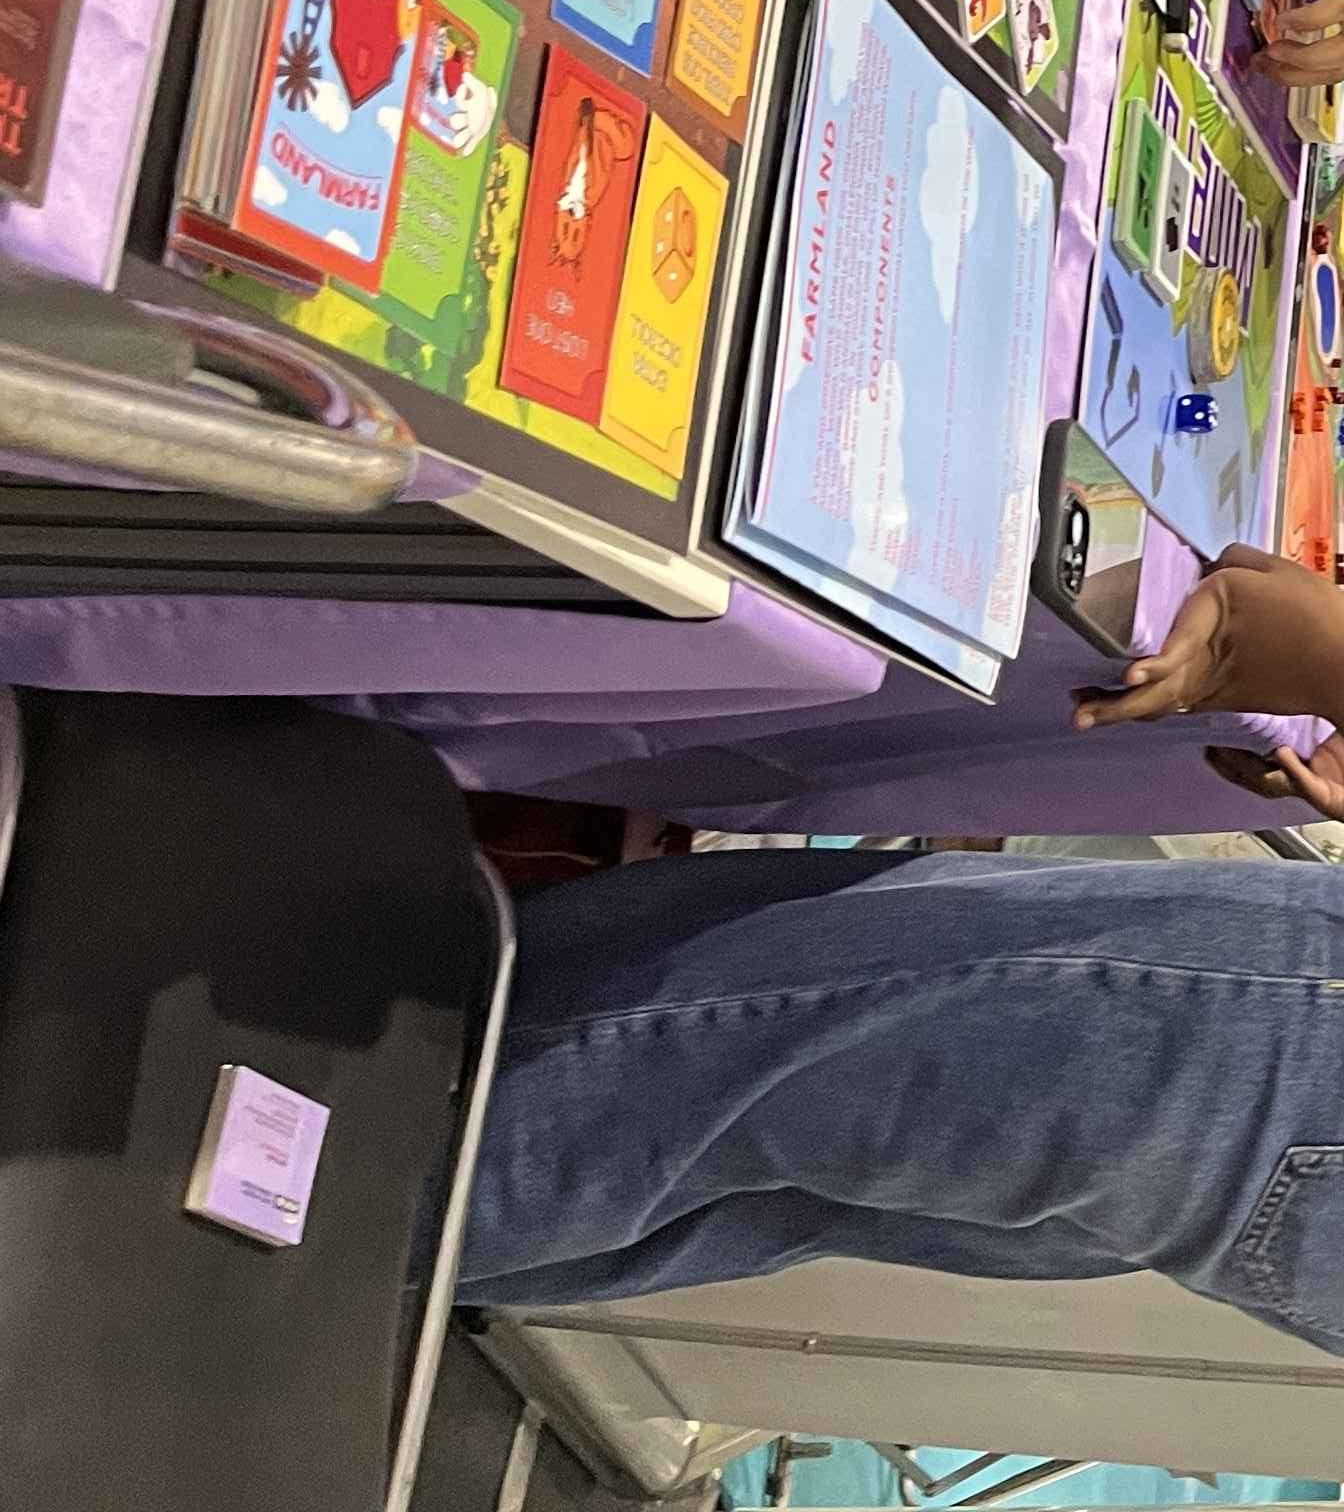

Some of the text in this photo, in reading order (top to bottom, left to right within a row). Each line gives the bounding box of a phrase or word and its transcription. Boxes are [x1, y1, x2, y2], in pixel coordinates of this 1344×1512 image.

[271, 131, 381, 211] FARMLAND
[800, 119, 838, 365] FARMLAND
[867, 173, 897, 405] COMPONENTS
